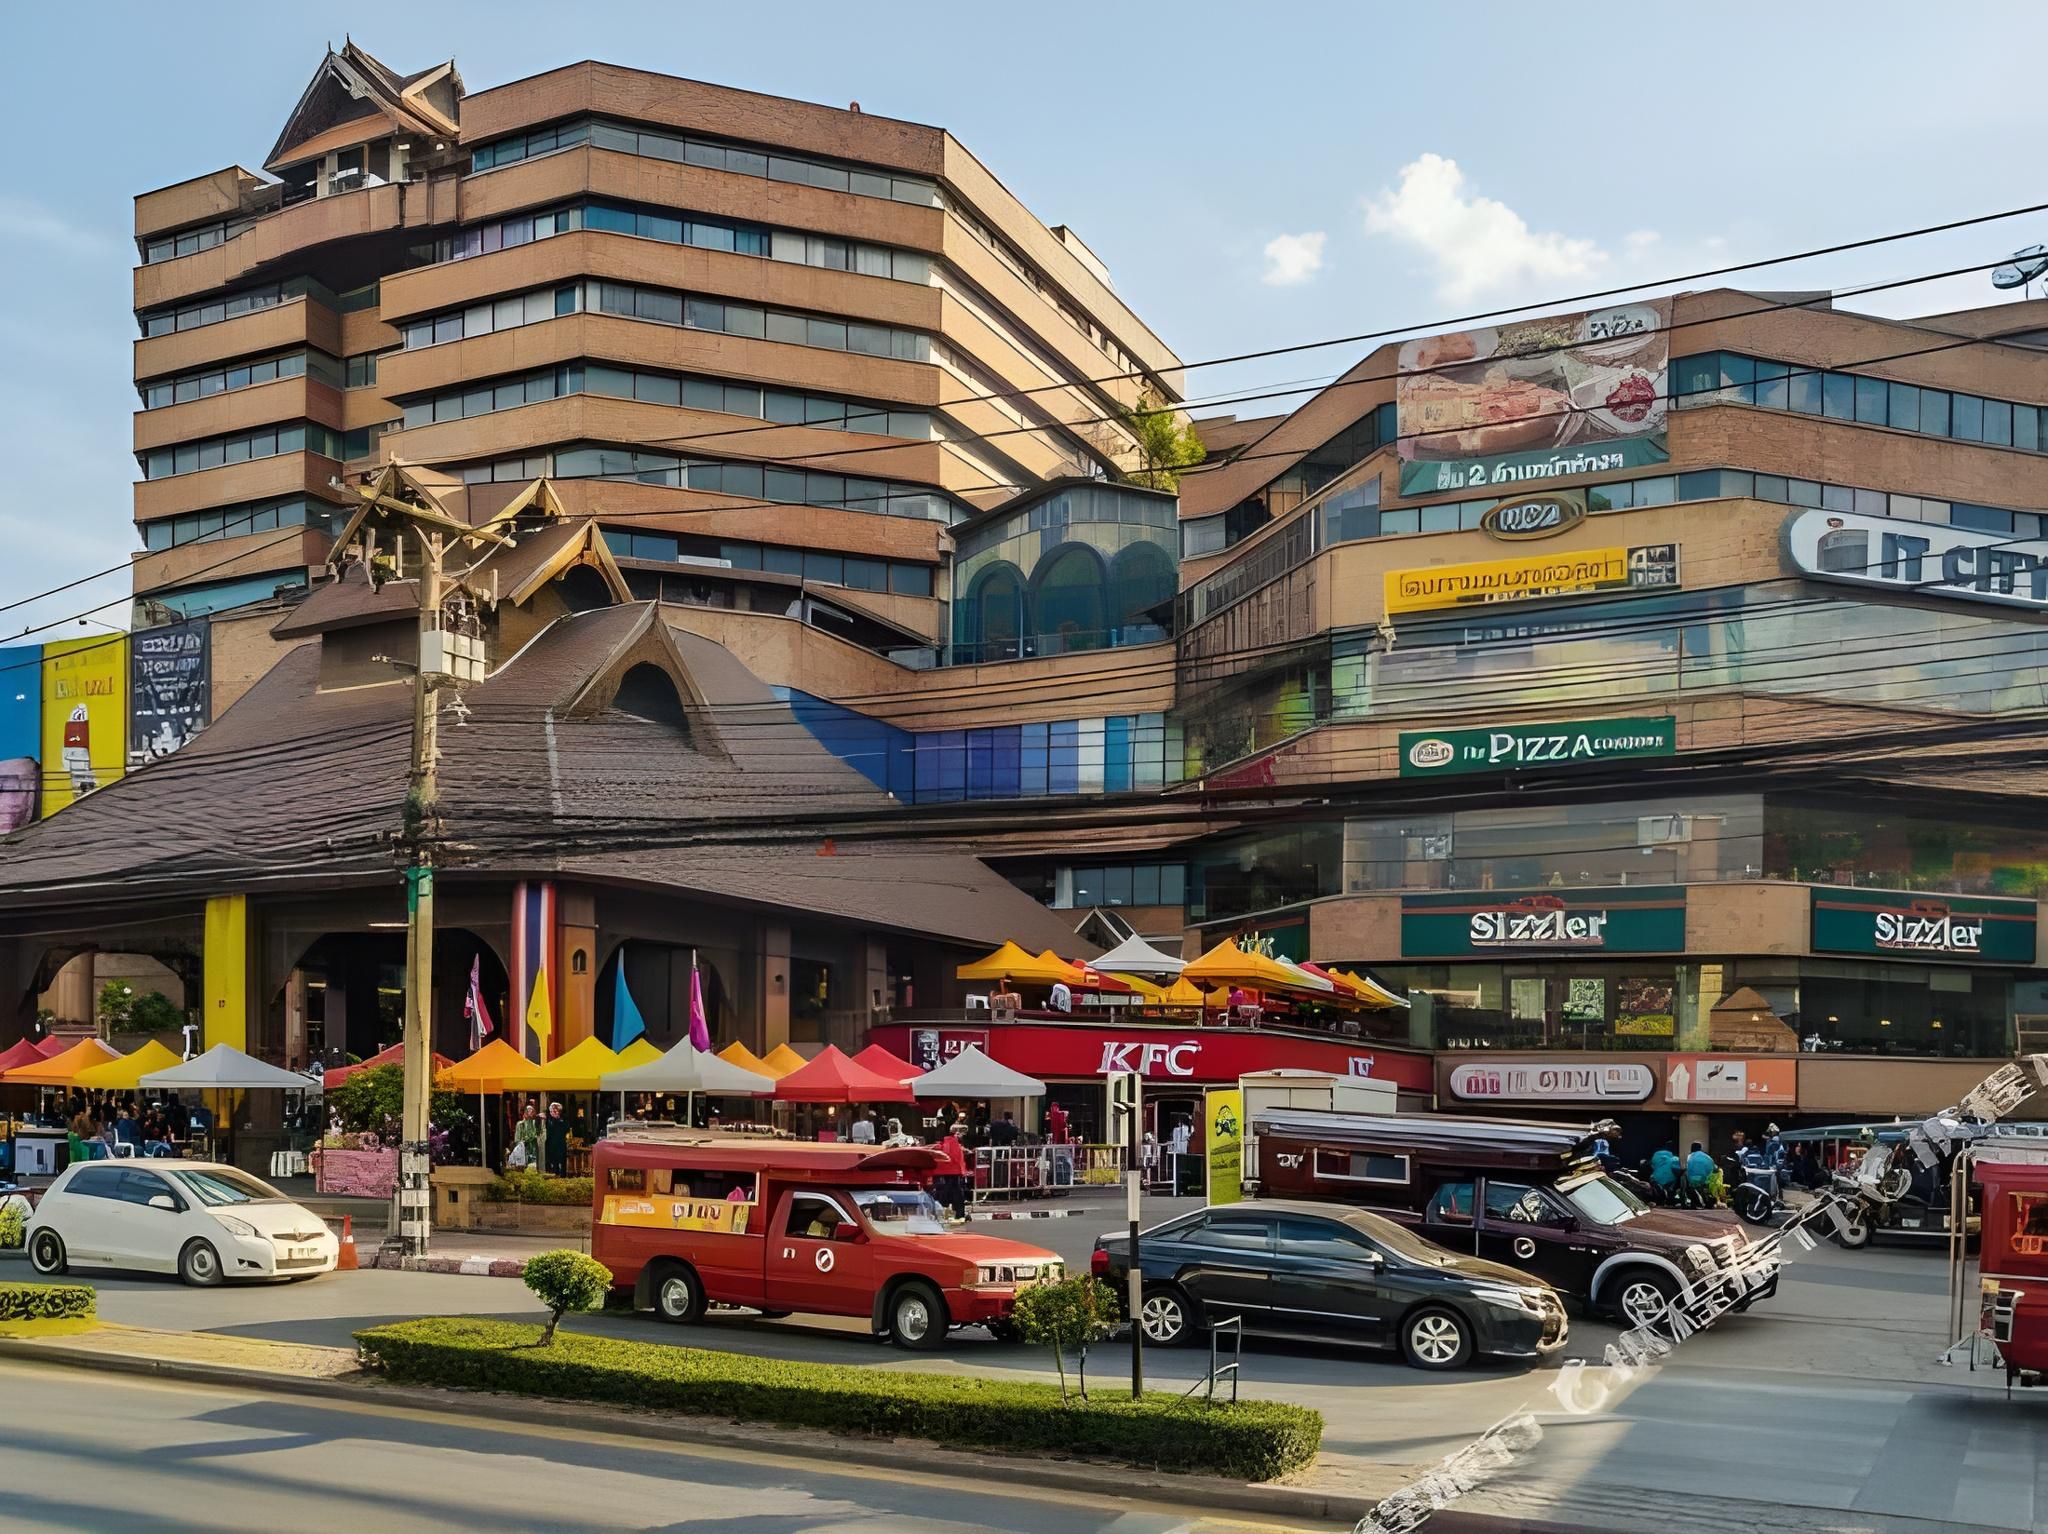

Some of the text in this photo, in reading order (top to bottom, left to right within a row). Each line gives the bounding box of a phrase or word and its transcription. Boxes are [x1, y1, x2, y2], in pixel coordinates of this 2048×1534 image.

[1489, 733, 1595, 763] PIZZA
[1470, 909, 1608, 941] Sizzler
[1875, 912, 1983, 947] Sizzler
[1096, 1040, 1202, 1076] KFC
